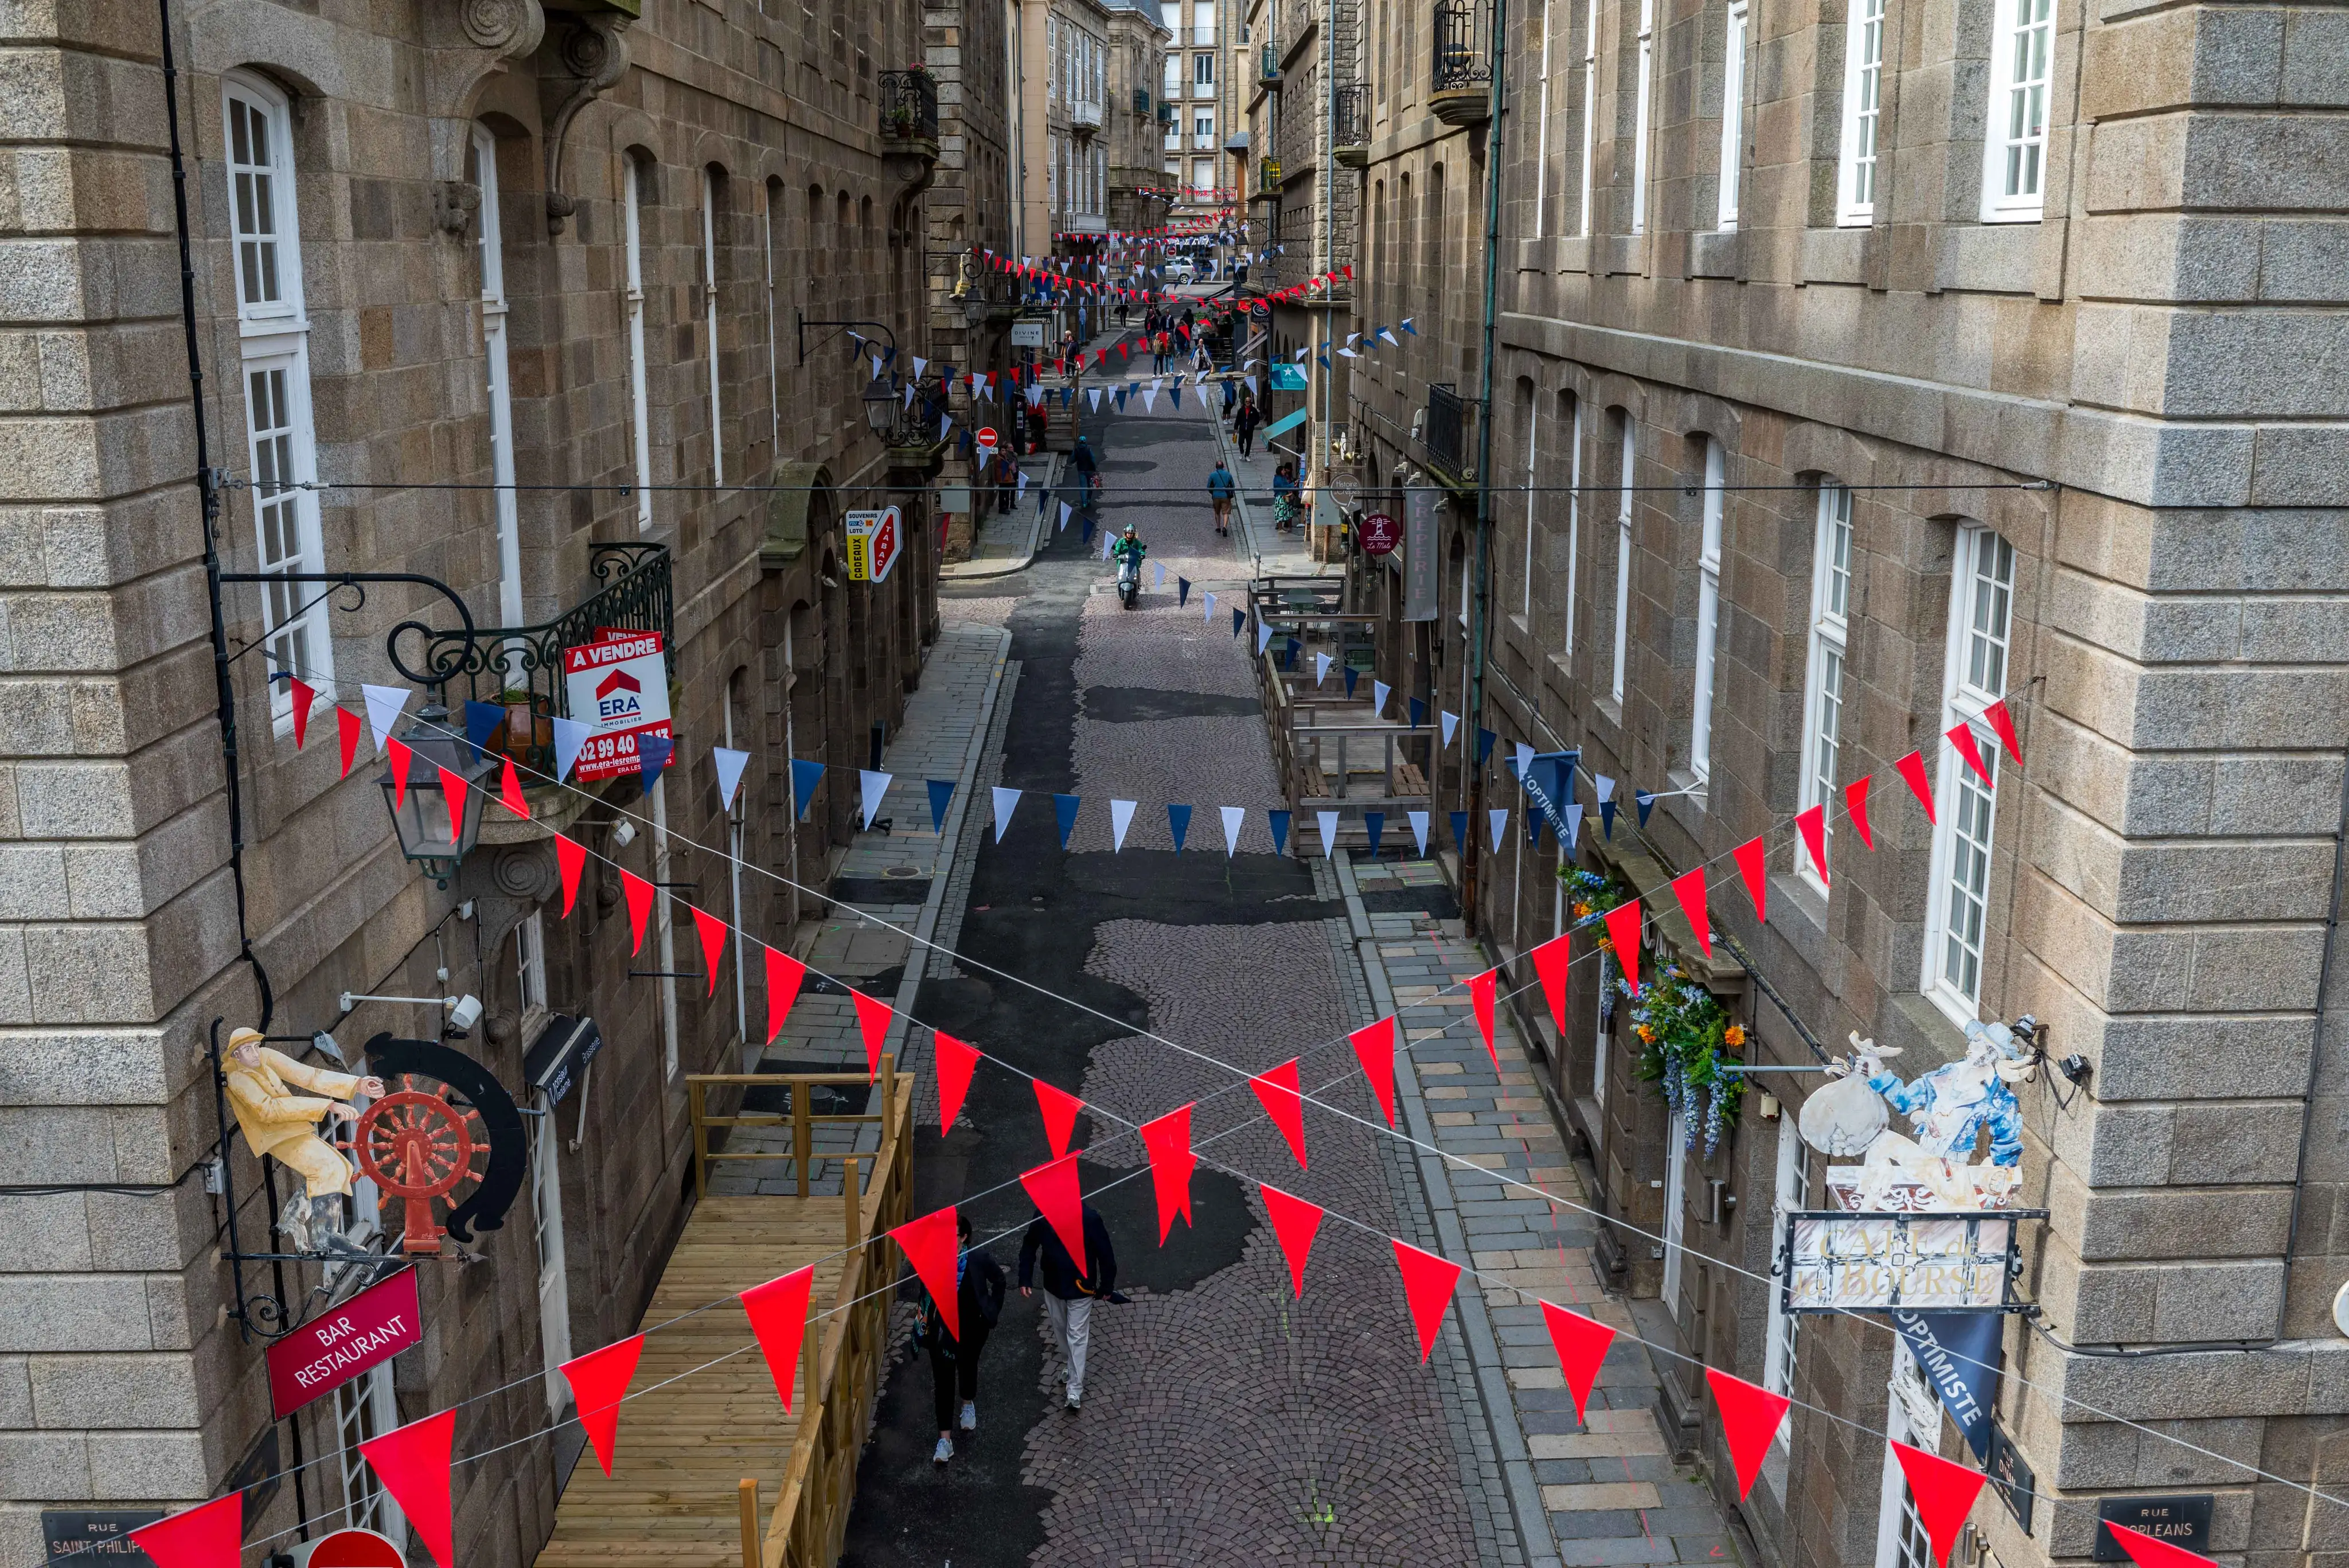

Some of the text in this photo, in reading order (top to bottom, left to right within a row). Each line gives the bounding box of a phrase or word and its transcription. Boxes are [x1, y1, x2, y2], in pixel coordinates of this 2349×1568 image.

[853, 539, 862, 578] CADEAUX
[877, 526, 891, 566] TABAC
[1415, 494, 1430, 599] CREPERIE
[573, 638, 656, 667] A VENDRE
[599, 696, 640, 716] ERA
[602, 717, 642, 727] IMMOBILIER
[579, 742, 596, 762] 02
[598, 738, 615, 759] 99
[617, 735, 635, 755] 40
[1527, 775, 1569, 838] 'OPTIMISTE
[582, 1036, 600, 1064] Brasserie
[1945, 1234, 1982, 1258] de
[1794, 1270, 1825, 1297] la
[316, 1317, 356, 1347] BAR
[294, 1315, 407, 1388] RESTAURANT
[1898, 1314, 1983, 1427] OPTIMISTE
[2003, 1447, 2014, 1468] RUE
[1999, 1459, 2016, 1491] DINAN
[2141, 1508, 2169, 1517] RUE
[88, 1524, 118, 1532] RUE
[2129, 1523, 2192, 1537] ORLEANS
[53, 1540, 145, 1554] SAINT PHILIP
